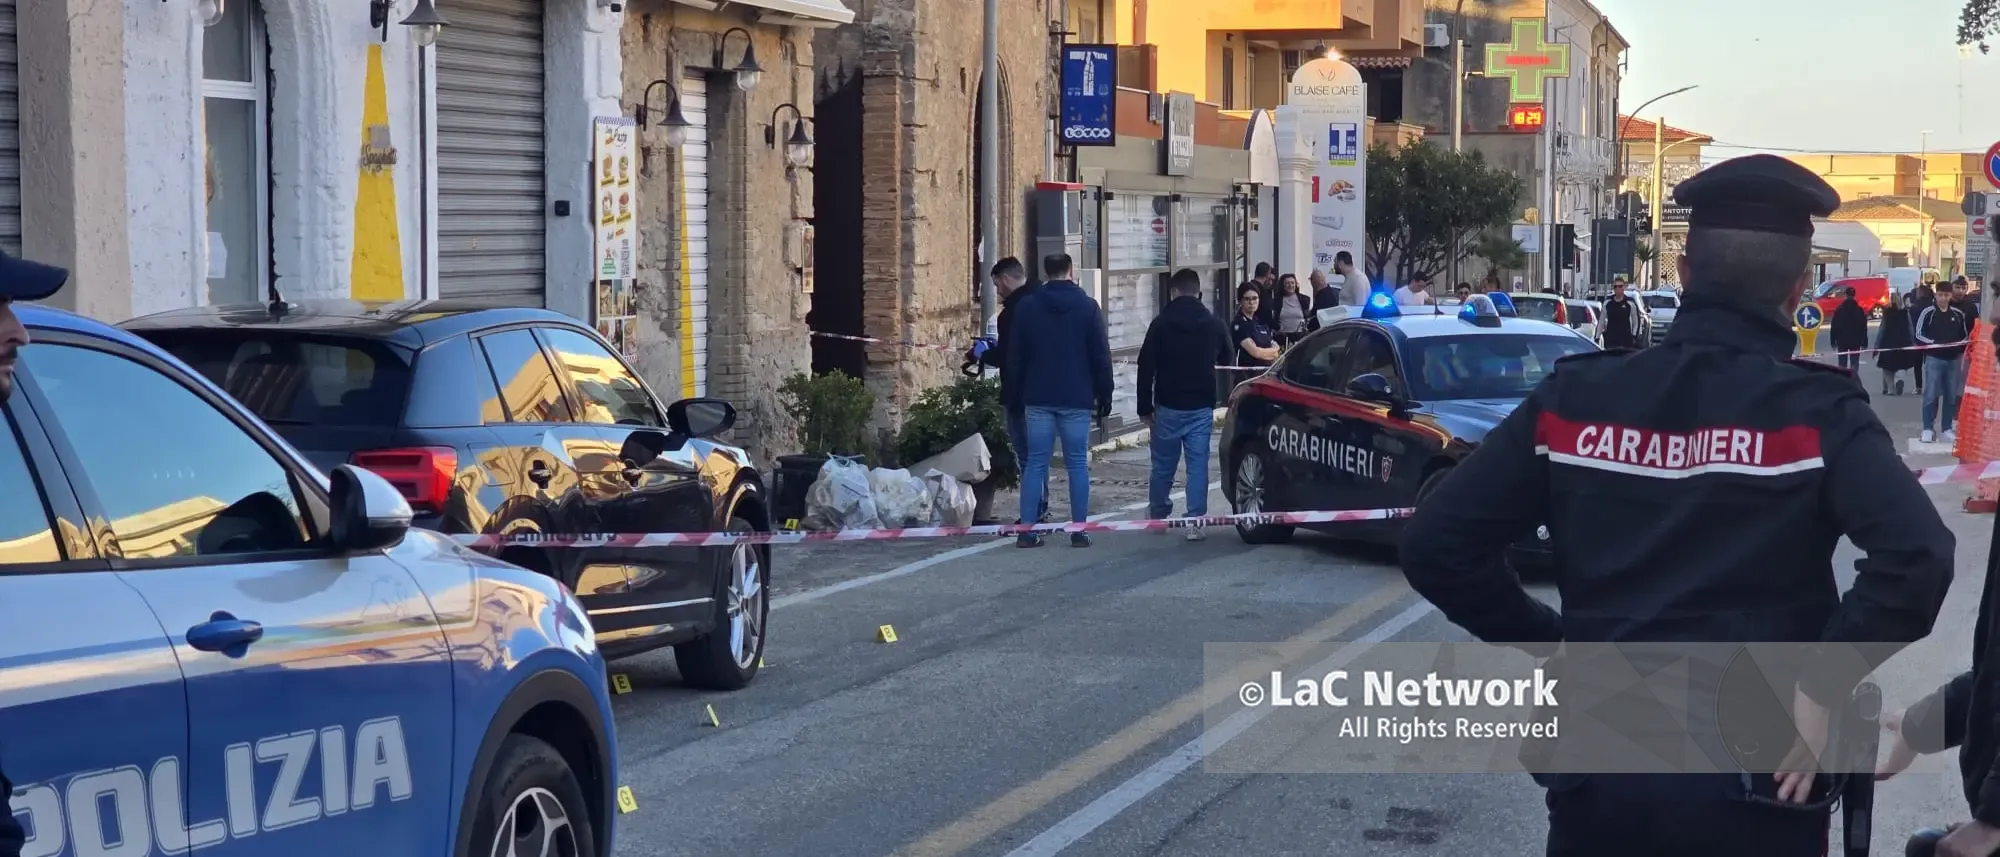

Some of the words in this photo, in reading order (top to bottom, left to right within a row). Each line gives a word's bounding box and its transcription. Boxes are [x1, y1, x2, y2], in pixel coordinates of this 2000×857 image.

[1294, 85, 1329, 96] BLAISE
[1268, 424, 1374, 479] CARABINIERI
[1576, 425, 1764, 468] CARABINIERI
[616, 675, 627, 690] E
[10, 715, 413, 857] POLIZIA
